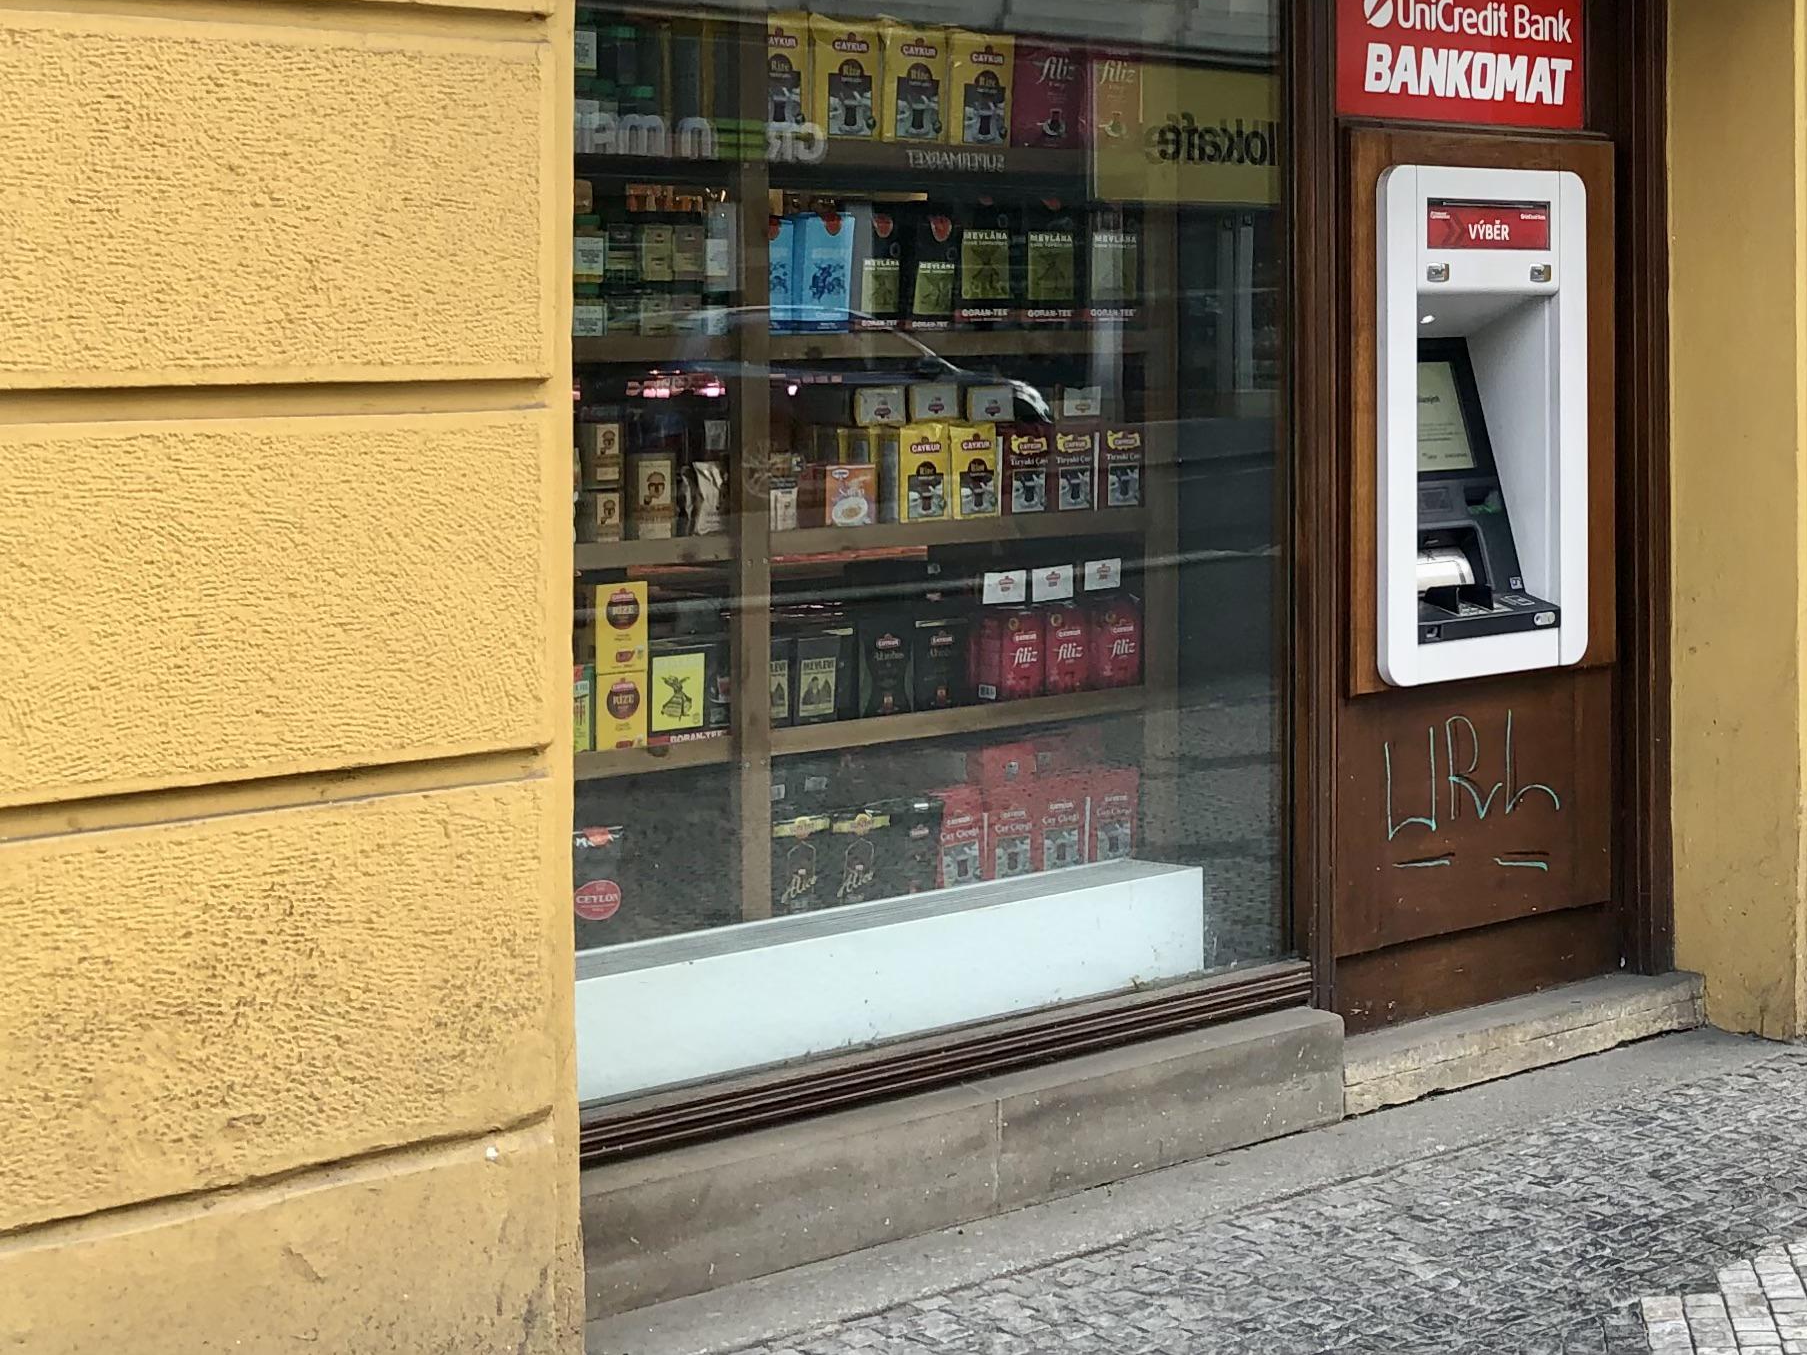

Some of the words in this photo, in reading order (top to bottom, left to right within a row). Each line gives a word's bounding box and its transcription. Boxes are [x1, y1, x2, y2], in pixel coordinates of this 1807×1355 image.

[1513, 4, 1573, 44] Bank
[1363, 42, 1573, 106] BANKOMAT
[1467, 219, 1511, 242] VÝBĚR
[1010, 646, 1039, 669] filiz
[1053, 642, 1084, 663] filiz
[1107, 638, 1136, 660] filiz
